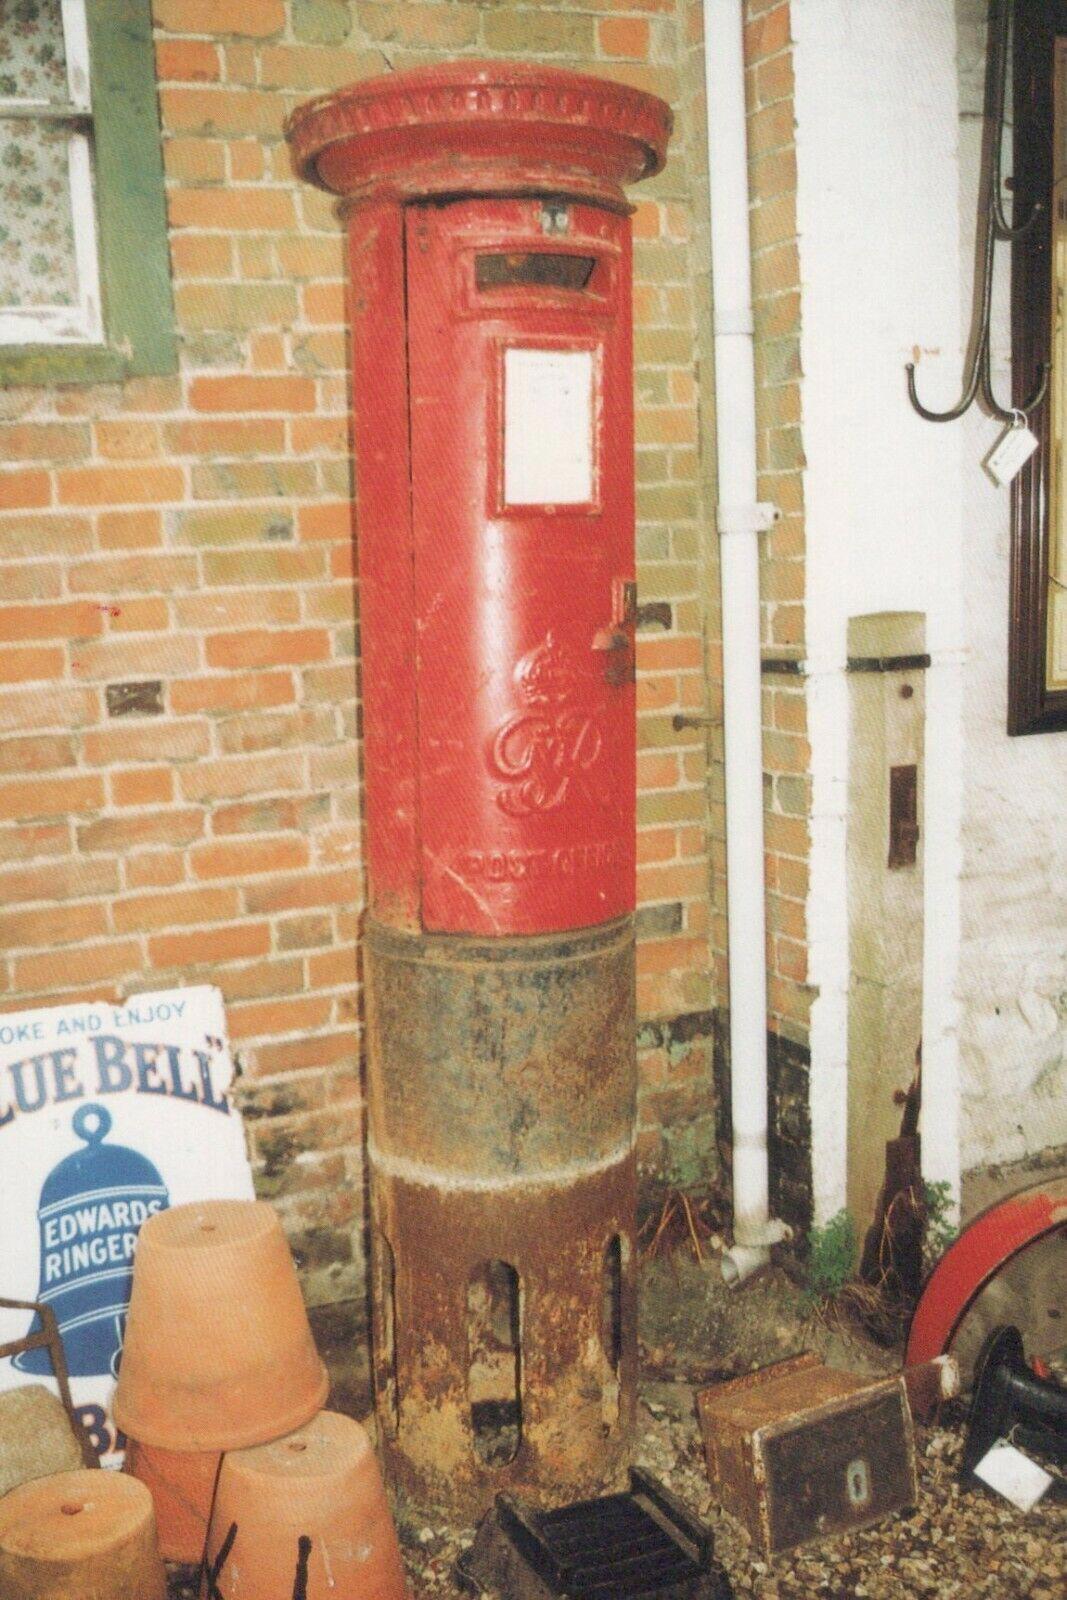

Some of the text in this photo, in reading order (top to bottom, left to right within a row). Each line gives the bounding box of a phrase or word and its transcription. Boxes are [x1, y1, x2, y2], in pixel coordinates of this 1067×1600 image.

[57, 1013, 102, 1036] AND
[113, 1001, 187, 1028] ENJOY
[44, 1199, 163, 1250] EDWARDS
